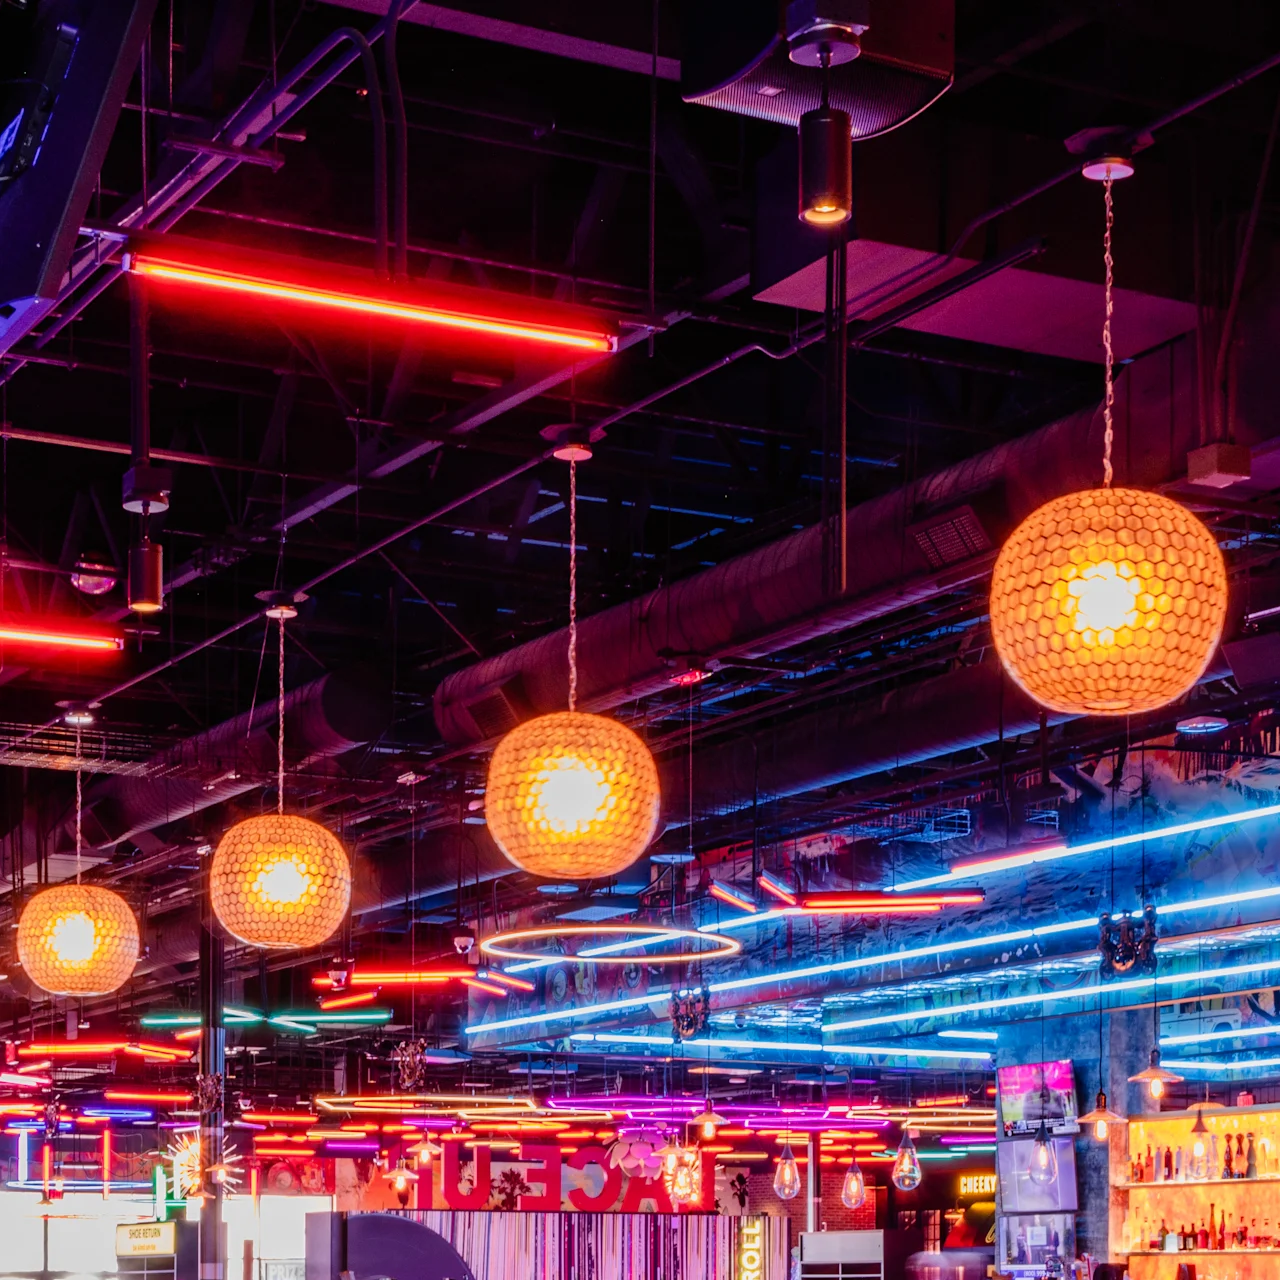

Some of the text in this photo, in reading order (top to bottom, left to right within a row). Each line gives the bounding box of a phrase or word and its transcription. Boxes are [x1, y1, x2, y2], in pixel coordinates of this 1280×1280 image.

[960, 1175, 996, 1194] CHEEKY
[128, 1227, 161, 1239] SHOE RETURN
[269, 1262, 306, 1280] PRIZE
